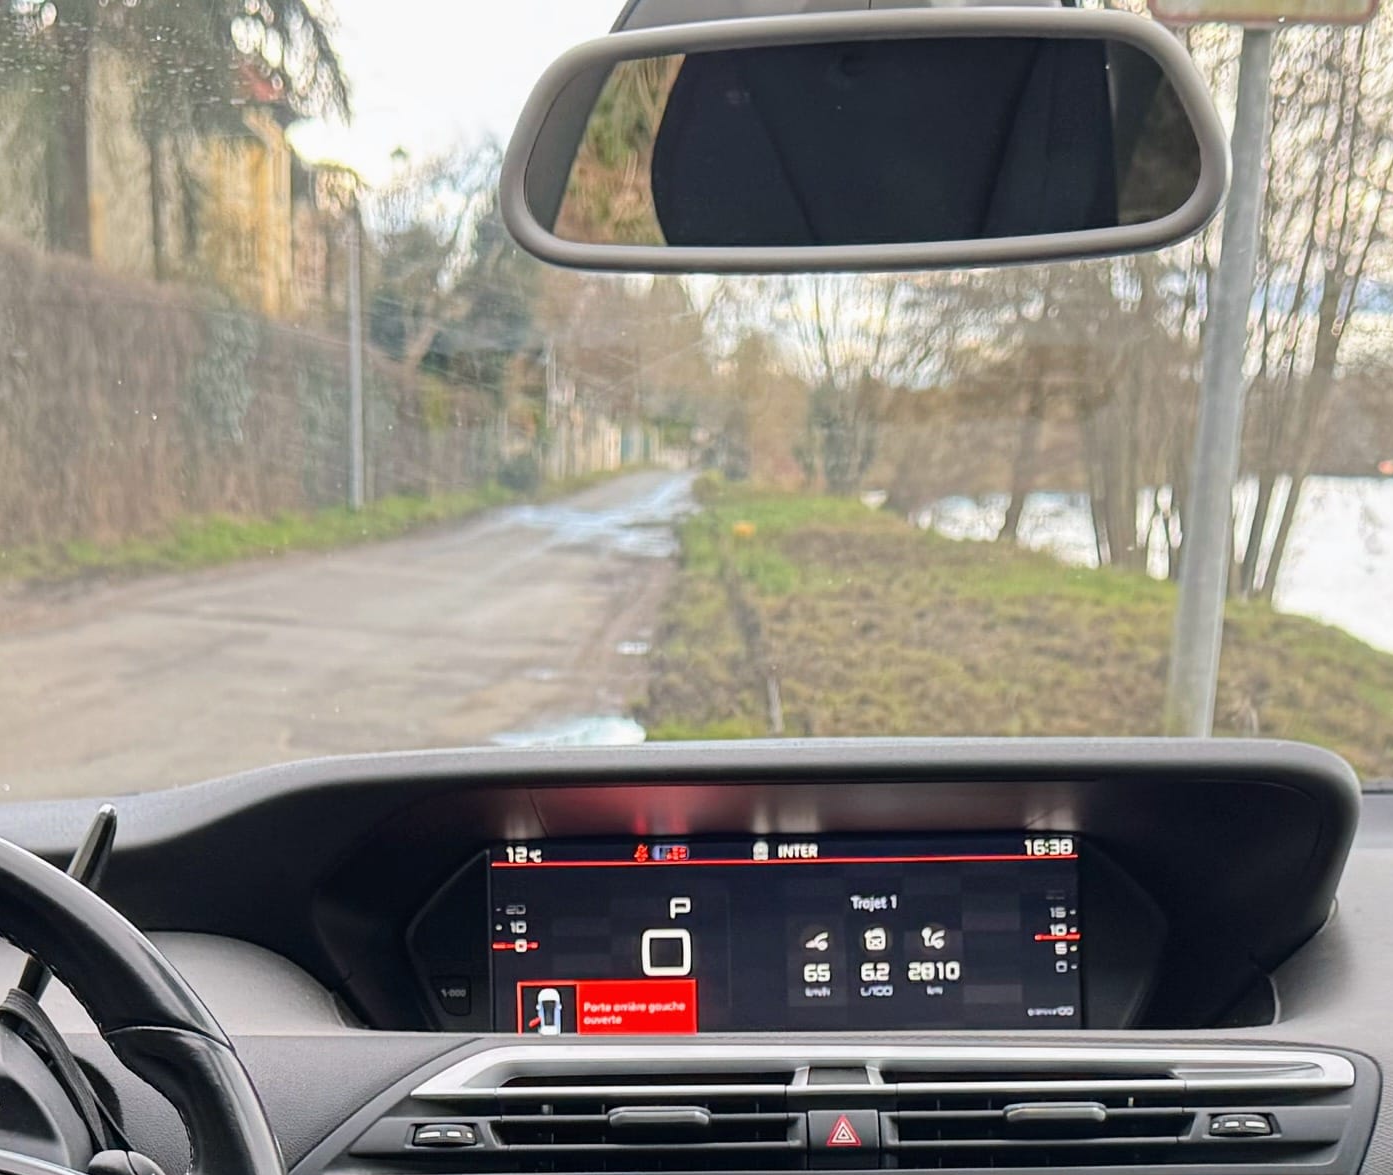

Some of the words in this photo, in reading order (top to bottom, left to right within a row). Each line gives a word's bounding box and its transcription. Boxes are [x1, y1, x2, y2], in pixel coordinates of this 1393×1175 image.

[777, 843, 818, 858] INTER
[1024, 838, 1073, 856] 16:38
[670, 897, 691, 918] P
[850, 896, 887, 911] Trajet
[890, 894, 897, 908] 1
[510, 920, 527, 933] 10
[1050, 924, 1067, 936] 10
[804, 963, 831, 982] 65
[1056, 961, 1068, 973] 0
[583, 1002, 611, 1012] Porte
[648, 1001, 686, 1014] gauche
[583, 1015, 622, 1025] ouverte
